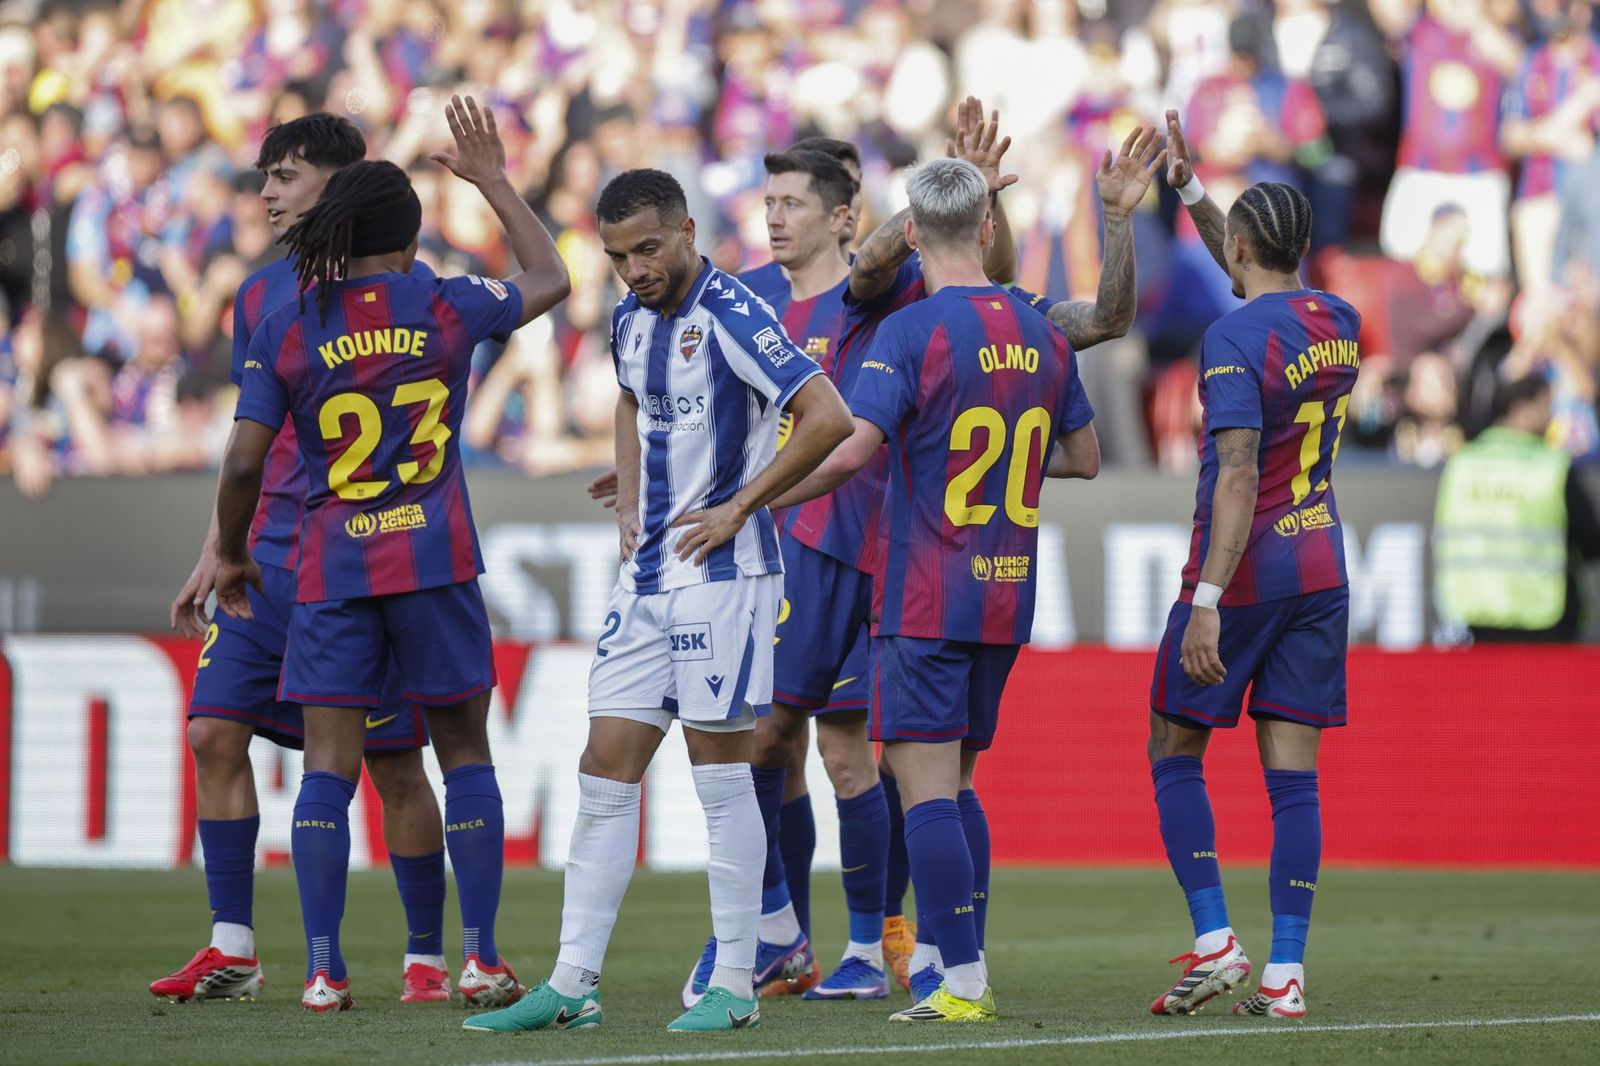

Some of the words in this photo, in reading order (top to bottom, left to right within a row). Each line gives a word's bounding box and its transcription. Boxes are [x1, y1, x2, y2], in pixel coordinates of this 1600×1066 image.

[318, 327, 428, 370] KOUNDE
[774, 351, 796, 369] HOME
[978, 343, 1040, 374] OLMO
[1284, 339, 1360, 391] RAPHINH
[318, 378, 452, 500] 23
[1290, 393, 1350, 506] 11
[944, 406, 1051, 528] 20
[378, 504, 423, 521] UNHCR
[380, 513, 426, 530] ACNUR
[993, 556, 1030, 567] UNHCR
[994, 567, 1028, 578] ACNUR
[198, 623, 219, 669] 2
[597, 611, 622, 657] 2
